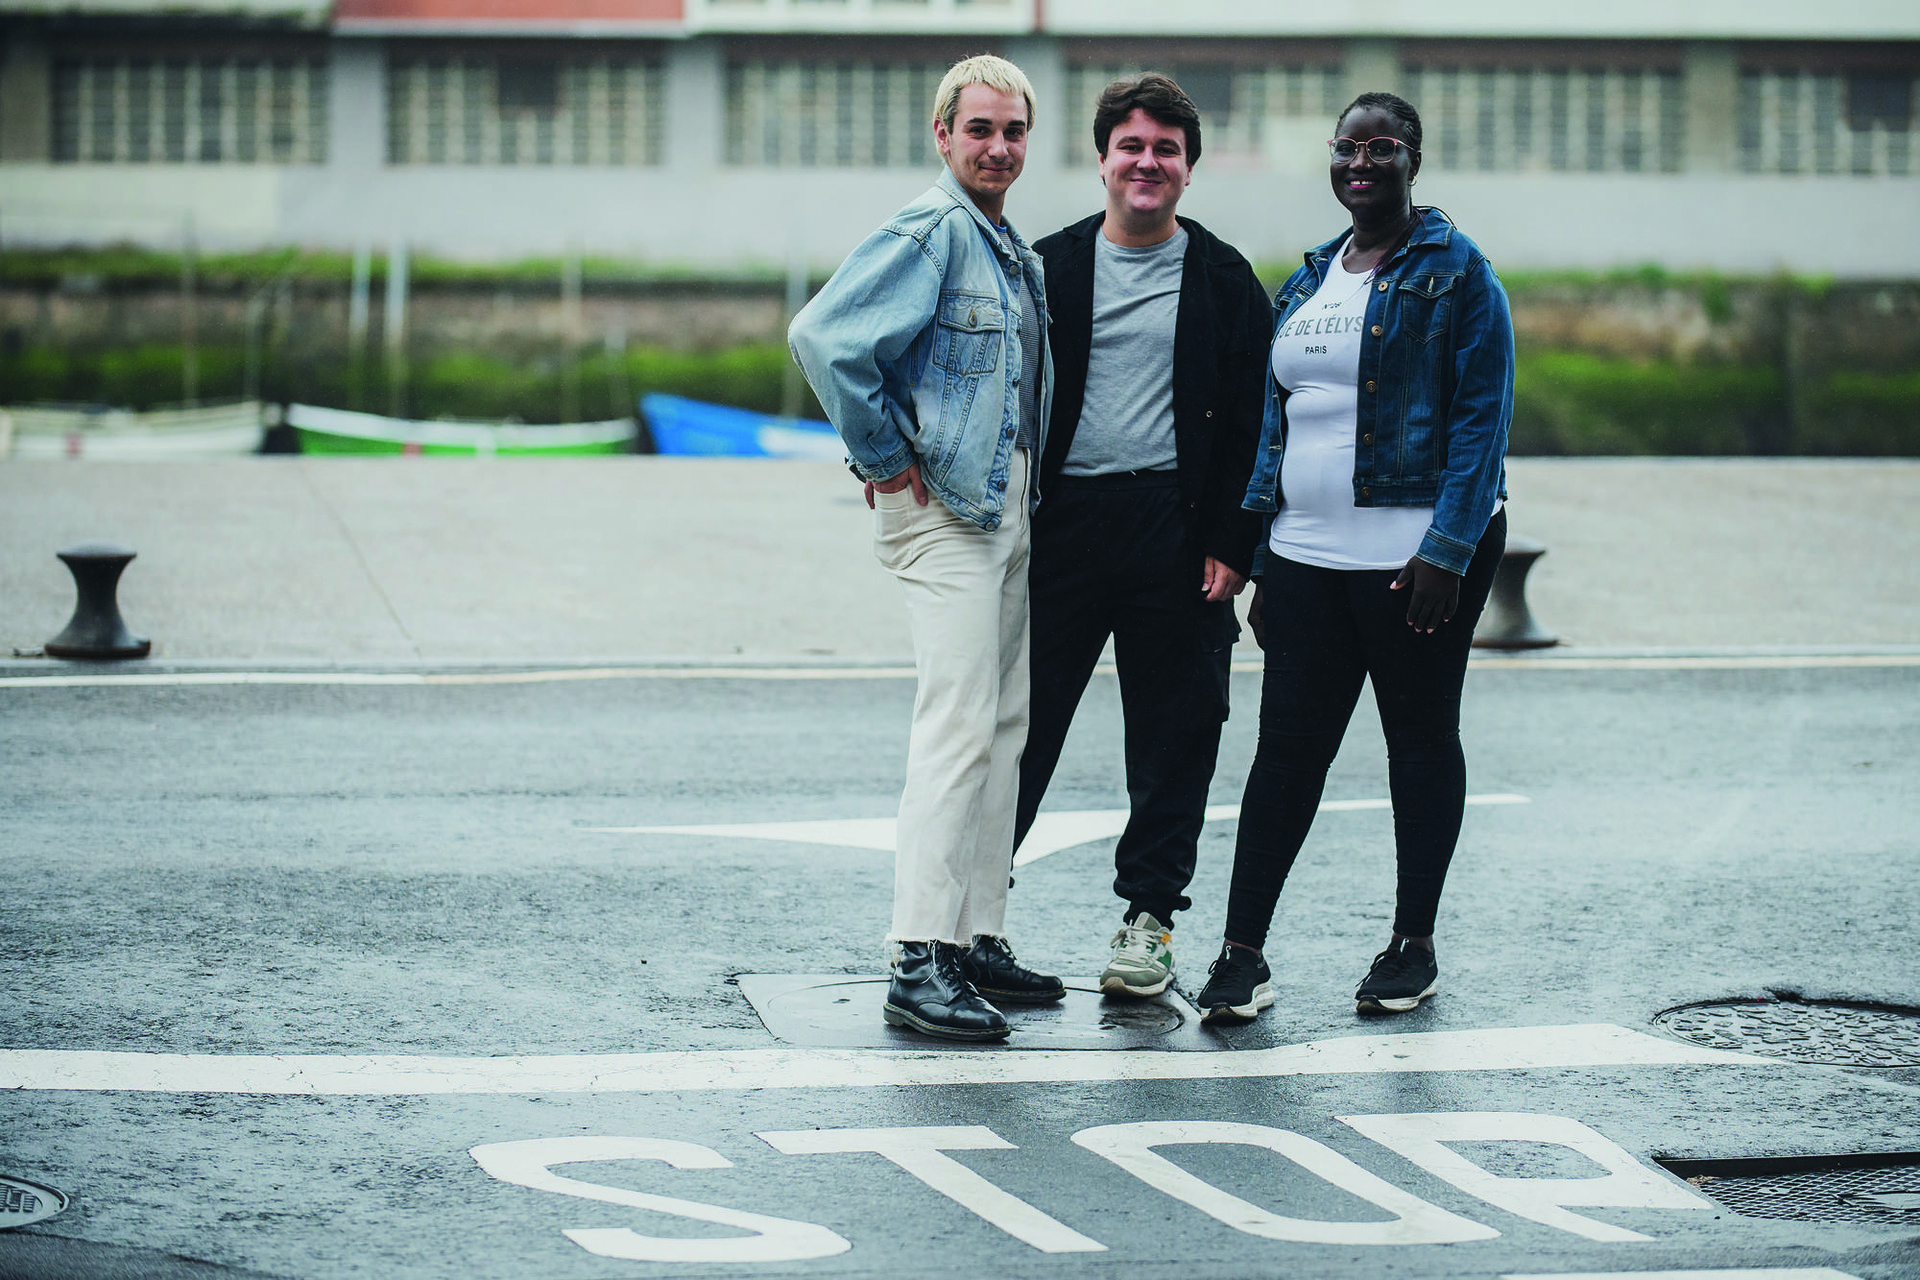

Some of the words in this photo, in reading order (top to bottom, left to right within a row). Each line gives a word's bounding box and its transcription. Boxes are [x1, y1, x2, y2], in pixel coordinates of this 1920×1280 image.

[1295, 318, 1315, 336] DE
[1304, 345, 1328, 355] PARIS
[467, 1113, 1715, 1261] STOP
